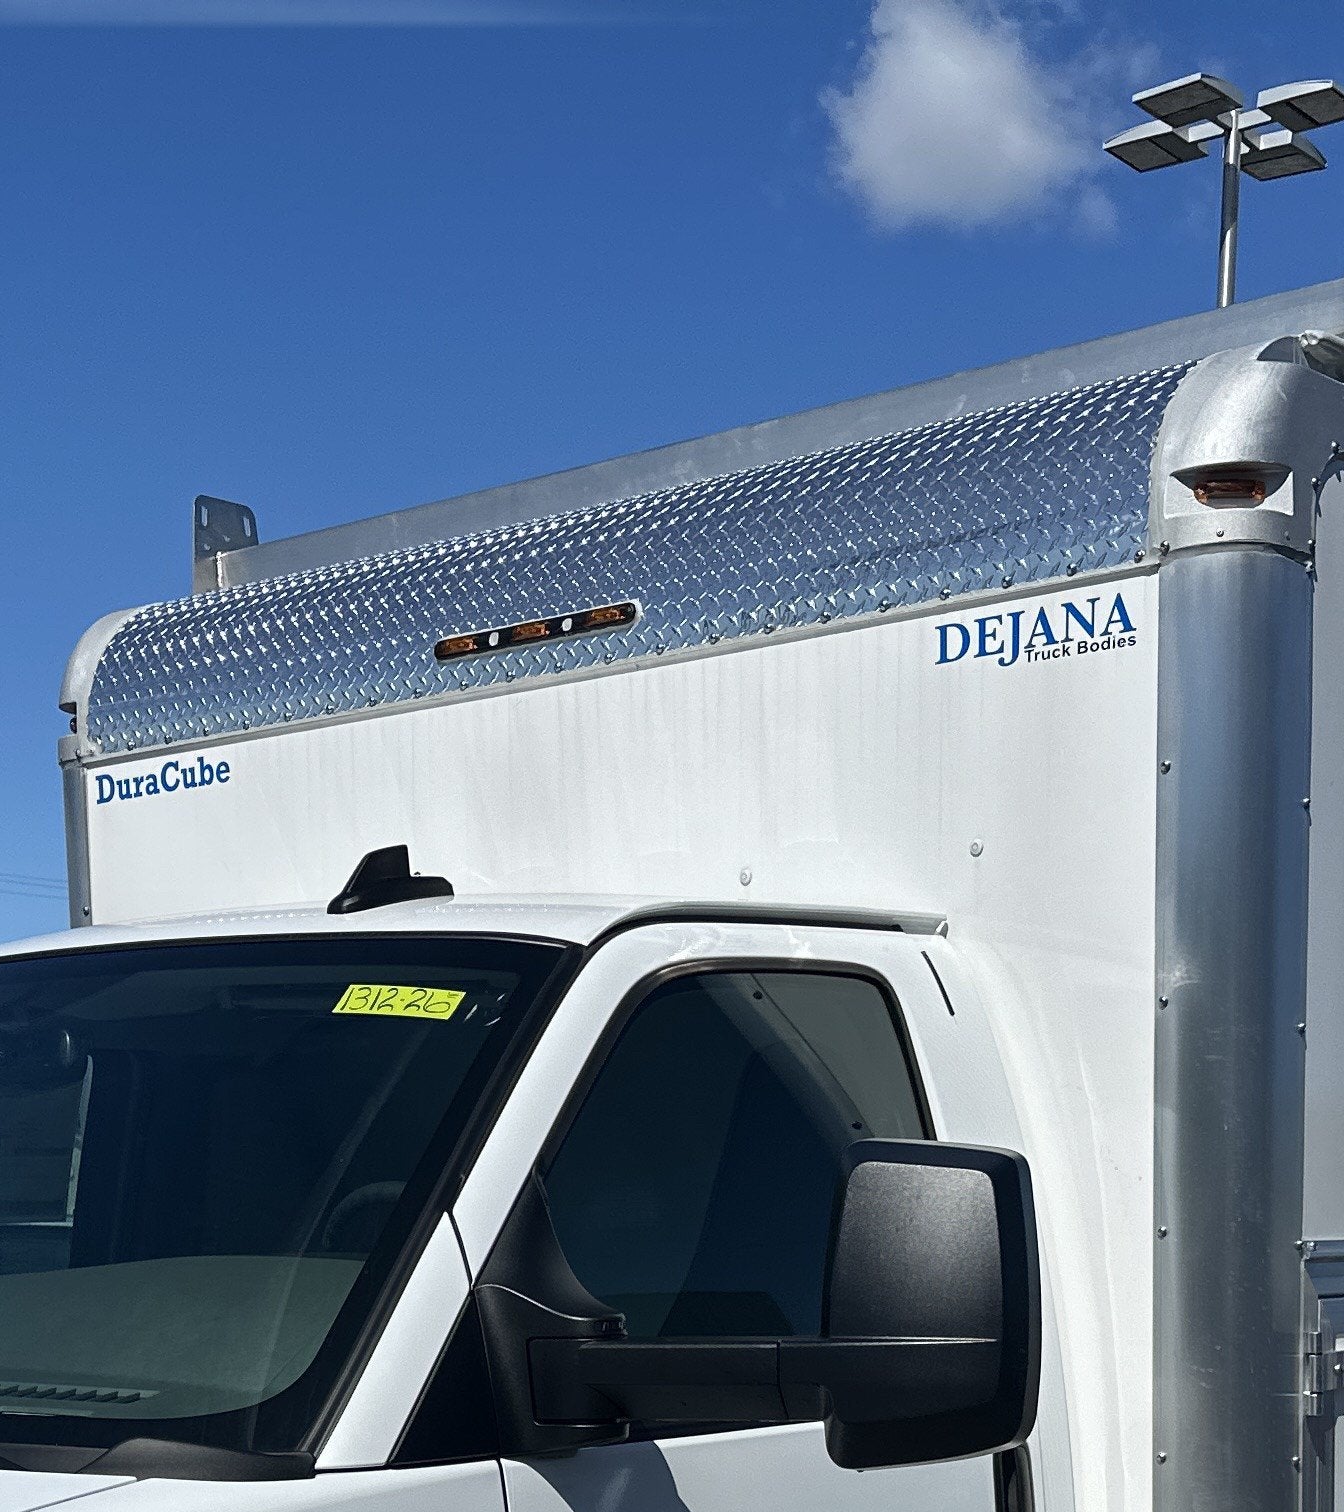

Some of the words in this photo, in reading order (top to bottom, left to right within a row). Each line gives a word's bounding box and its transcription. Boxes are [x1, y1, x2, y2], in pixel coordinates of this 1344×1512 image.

[934, 592, 1137, 667] DEJANA
[1024, 643, 1072, 664] Truck
[1077, 635, 1137, 655] Bodies
[95, 756, 231, 805] DuraCube
